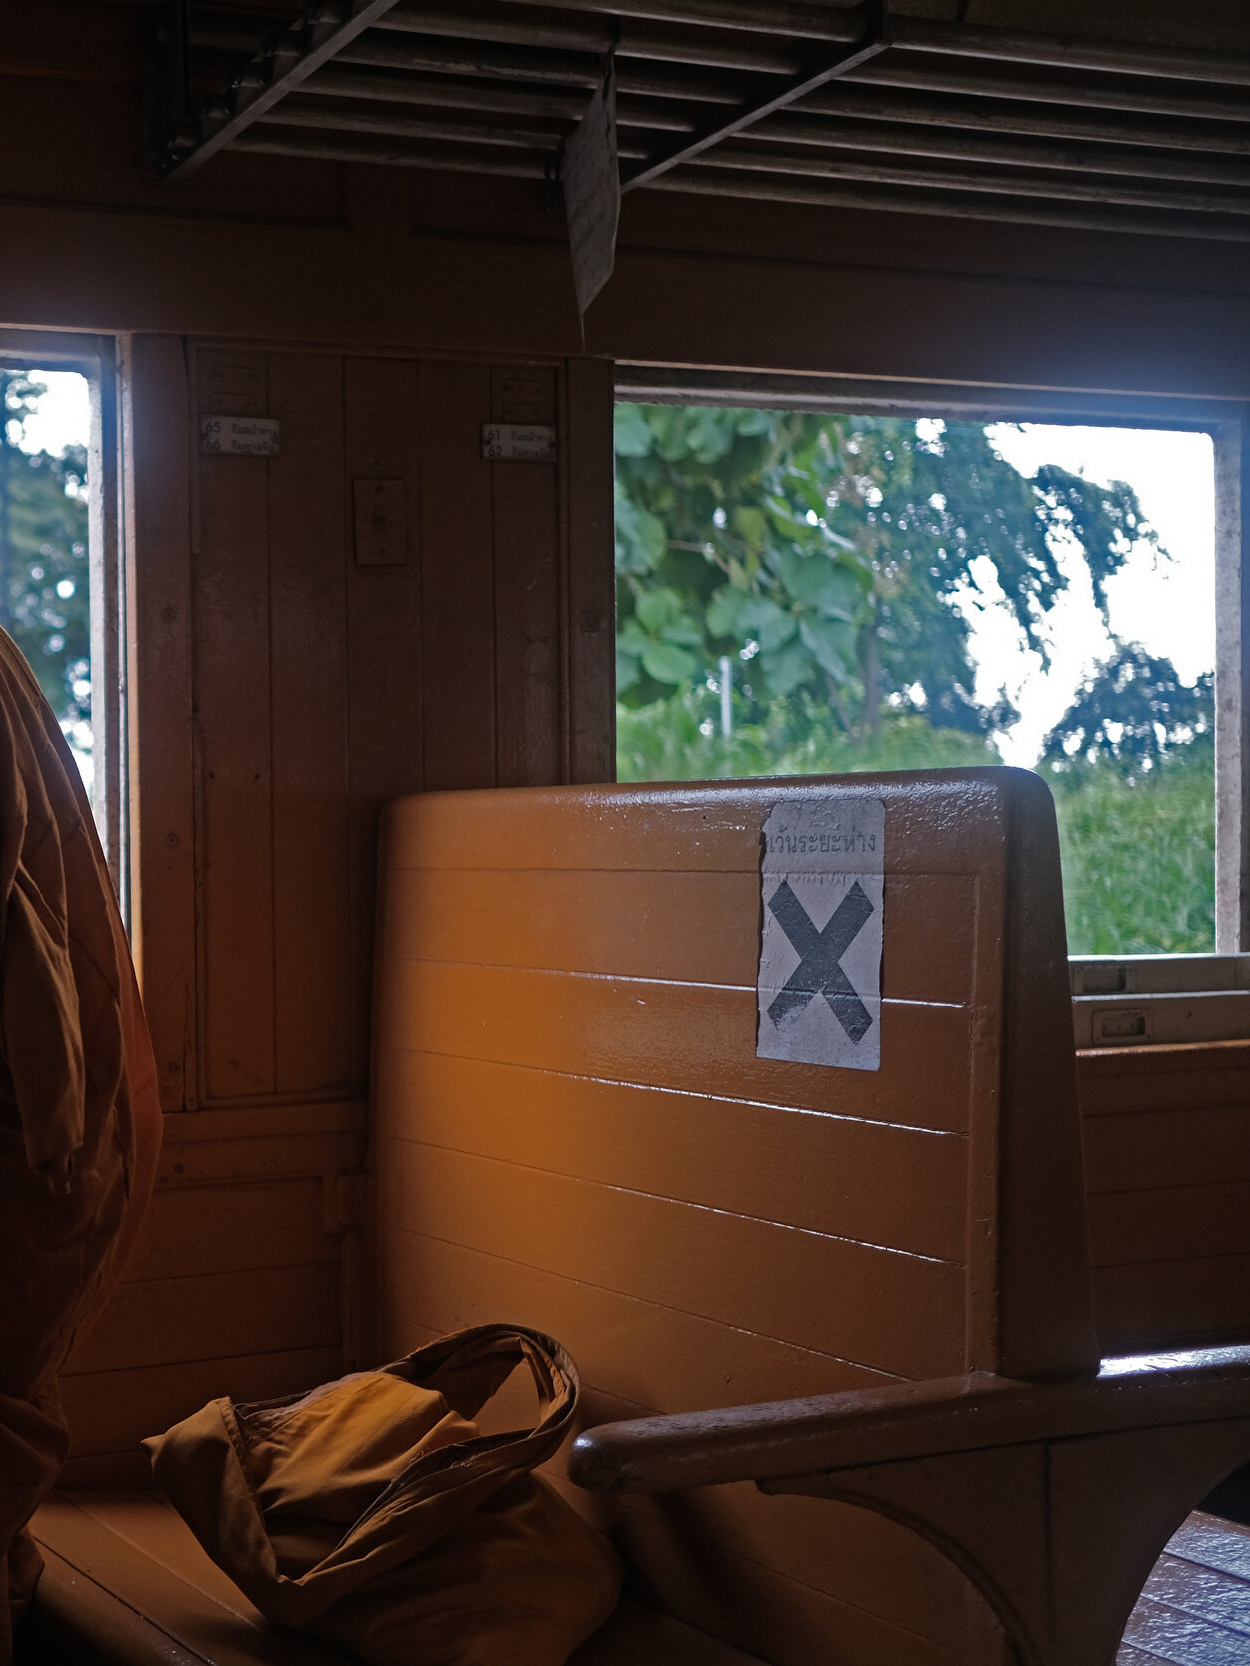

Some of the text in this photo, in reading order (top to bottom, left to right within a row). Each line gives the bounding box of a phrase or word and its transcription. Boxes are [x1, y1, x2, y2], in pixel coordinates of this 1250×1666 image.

[205, 420, 222, 433] 65
[205, 438, 222, 450] 66
[488, 445, 503, 457] 62
[768, 824, 877, 853] เว้นระยะห่าง
